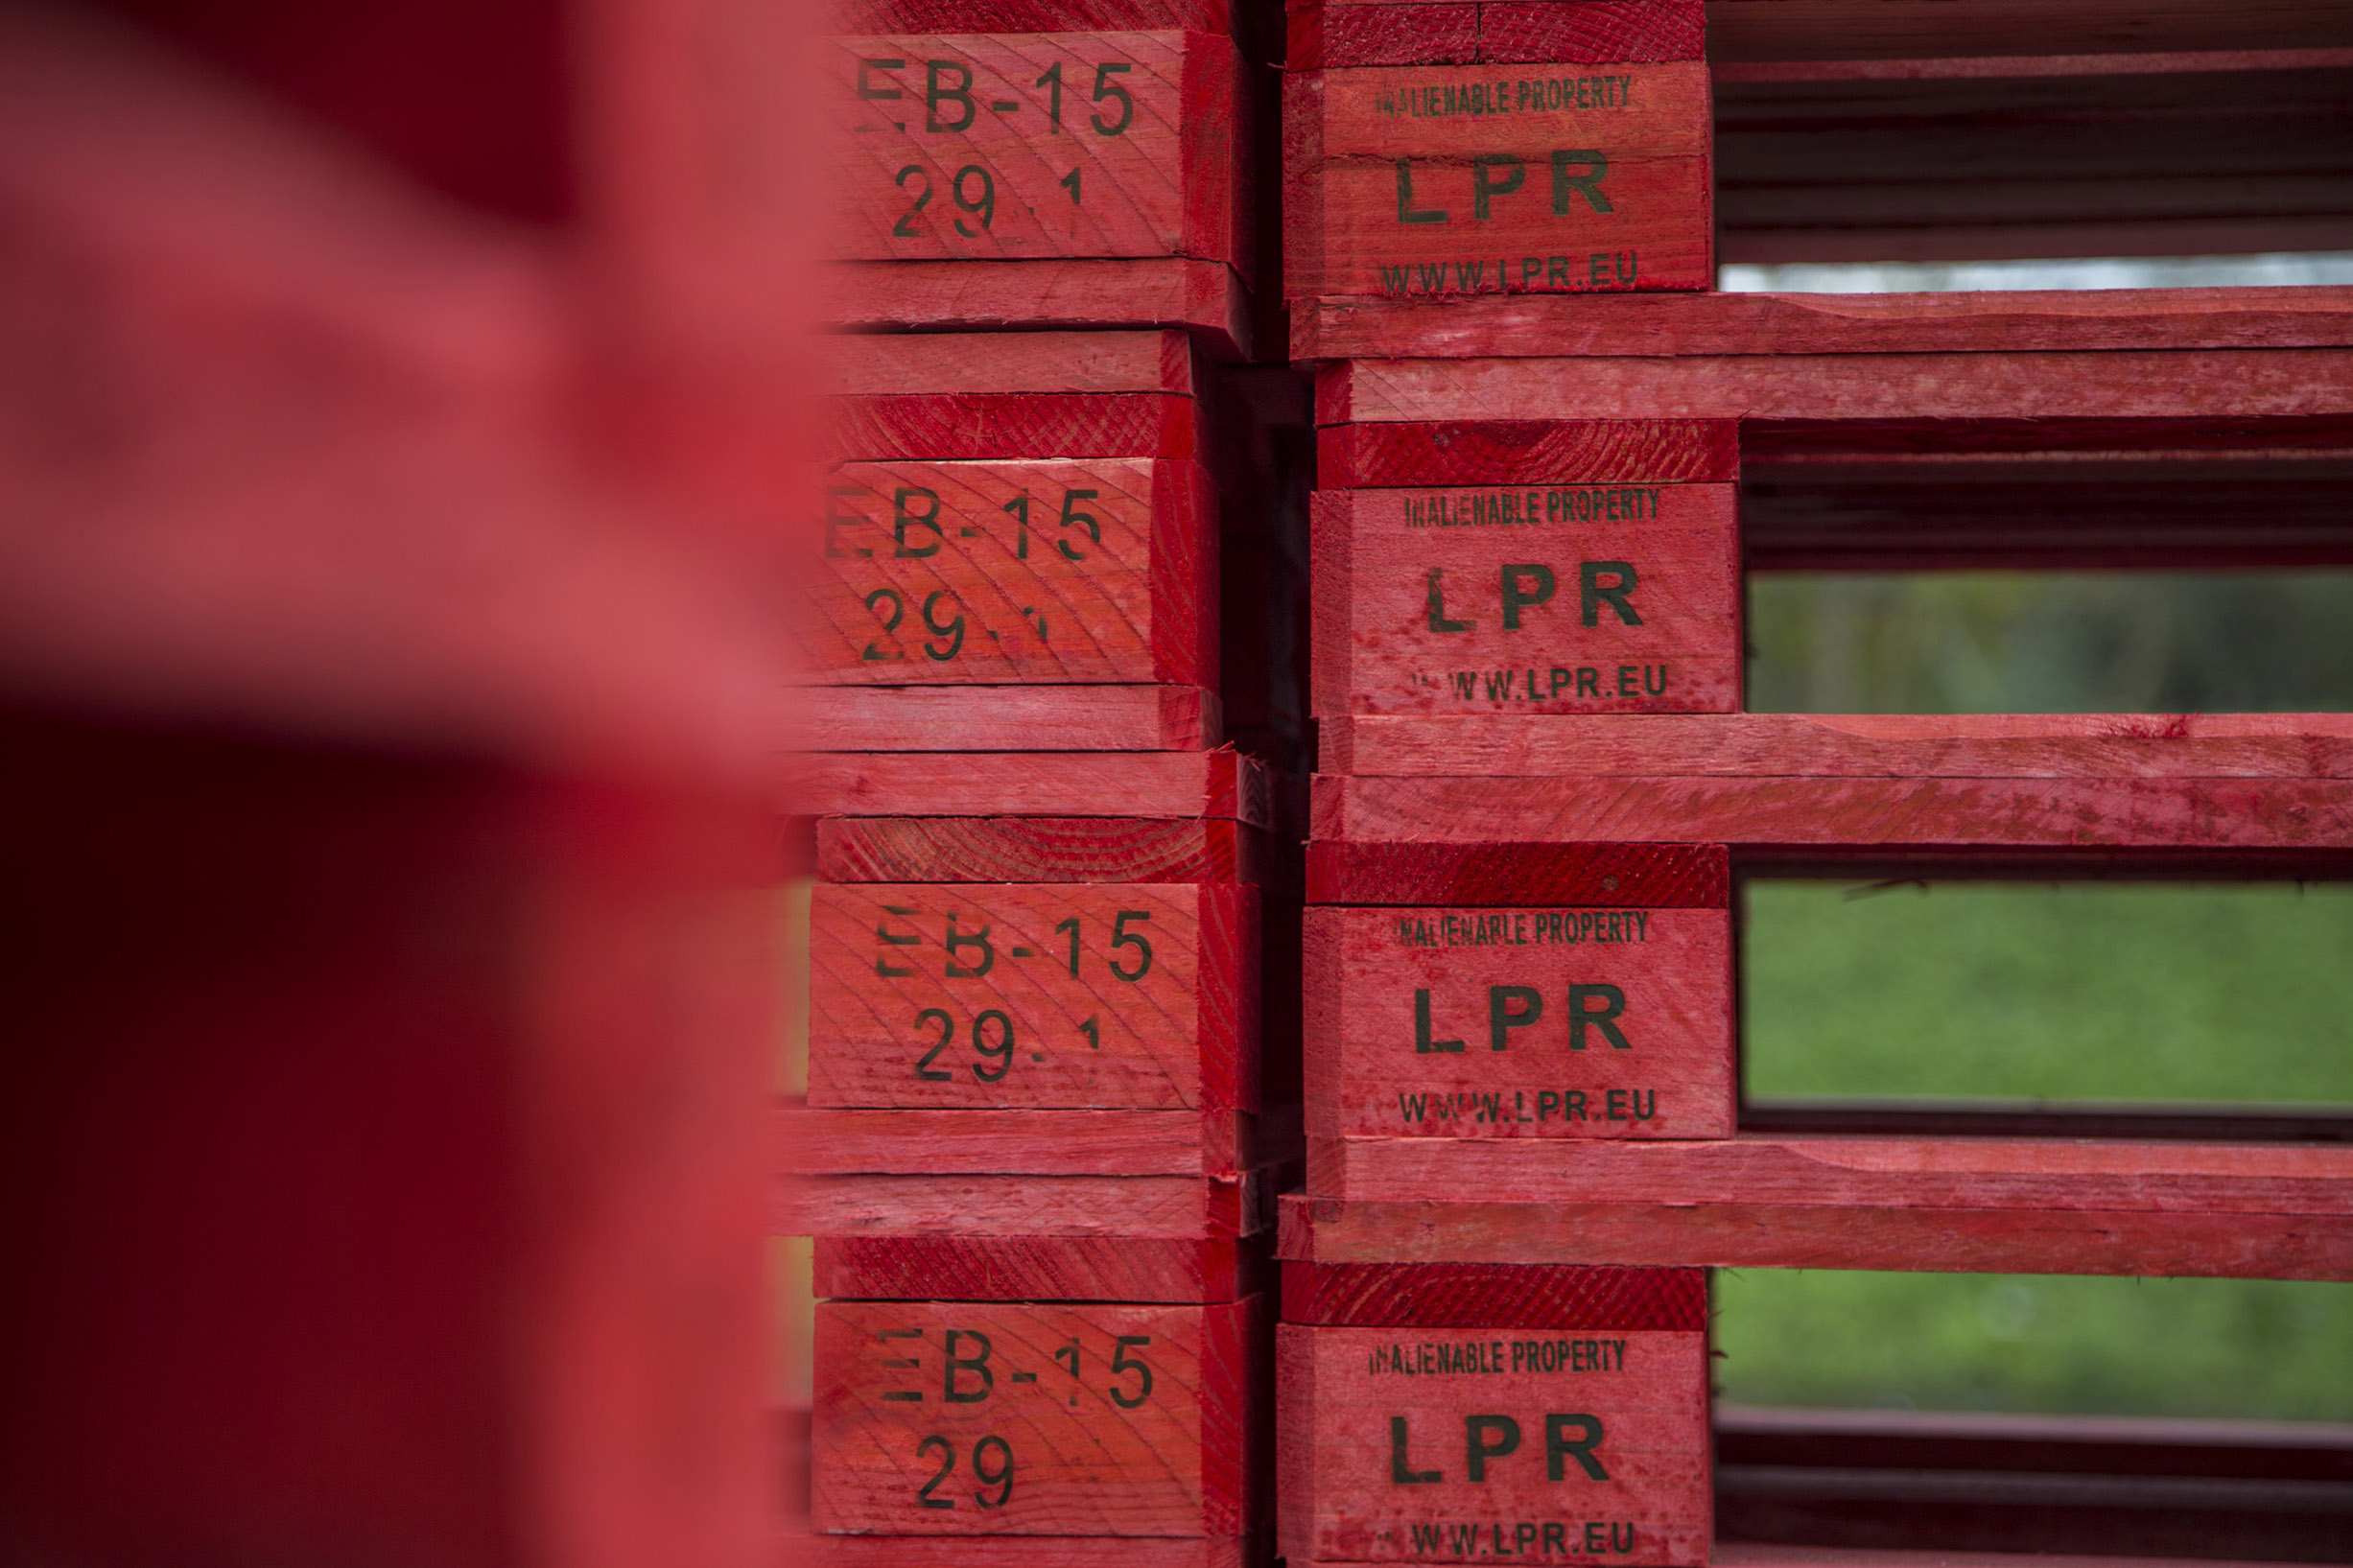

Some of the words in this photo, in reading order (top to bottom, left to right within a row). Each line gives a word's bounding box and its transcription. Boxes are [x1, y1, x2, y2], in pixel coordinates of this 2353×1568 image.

[857, 59, 1135, 136] EB-15
[1376, 82, 1511, 119] INALIENABLE
[1518, 75, 1632, 112] PROPERTY
[1396, 149, 1614, 224] LPR
[1381, 252, 1638, 293] WWW.LPR.EU
[826, 486, 1100, 561] EB-15
[1405, 491, 1540, 528] INALIENABLE
[1546, 487, 1661, 523] PROPERTY
[1427, 560, 1643, 633] LPR
[1411, 665, 1667, 702] WW.LPR.EU
[876, 905, 1152, 983] EB-15
[1393, 913, 1527, 948] NALIENABLE
[1535, 911, 1649, 945] PROPERTY
[1415, 983, 1632, 1054] LPR
[1399, 1089, 1656, 1124] WWW.LPR.EU
[877, 1329, 1153, 1409] EB-15
[1512, 1339, 1626, 1373] PROPERTY
[914, 1435, 1016, 1509] 29
[1391, 1413, 1611, 1485] LPR
[1377, 1521, 1634, 1556] WW.LPR.EU
